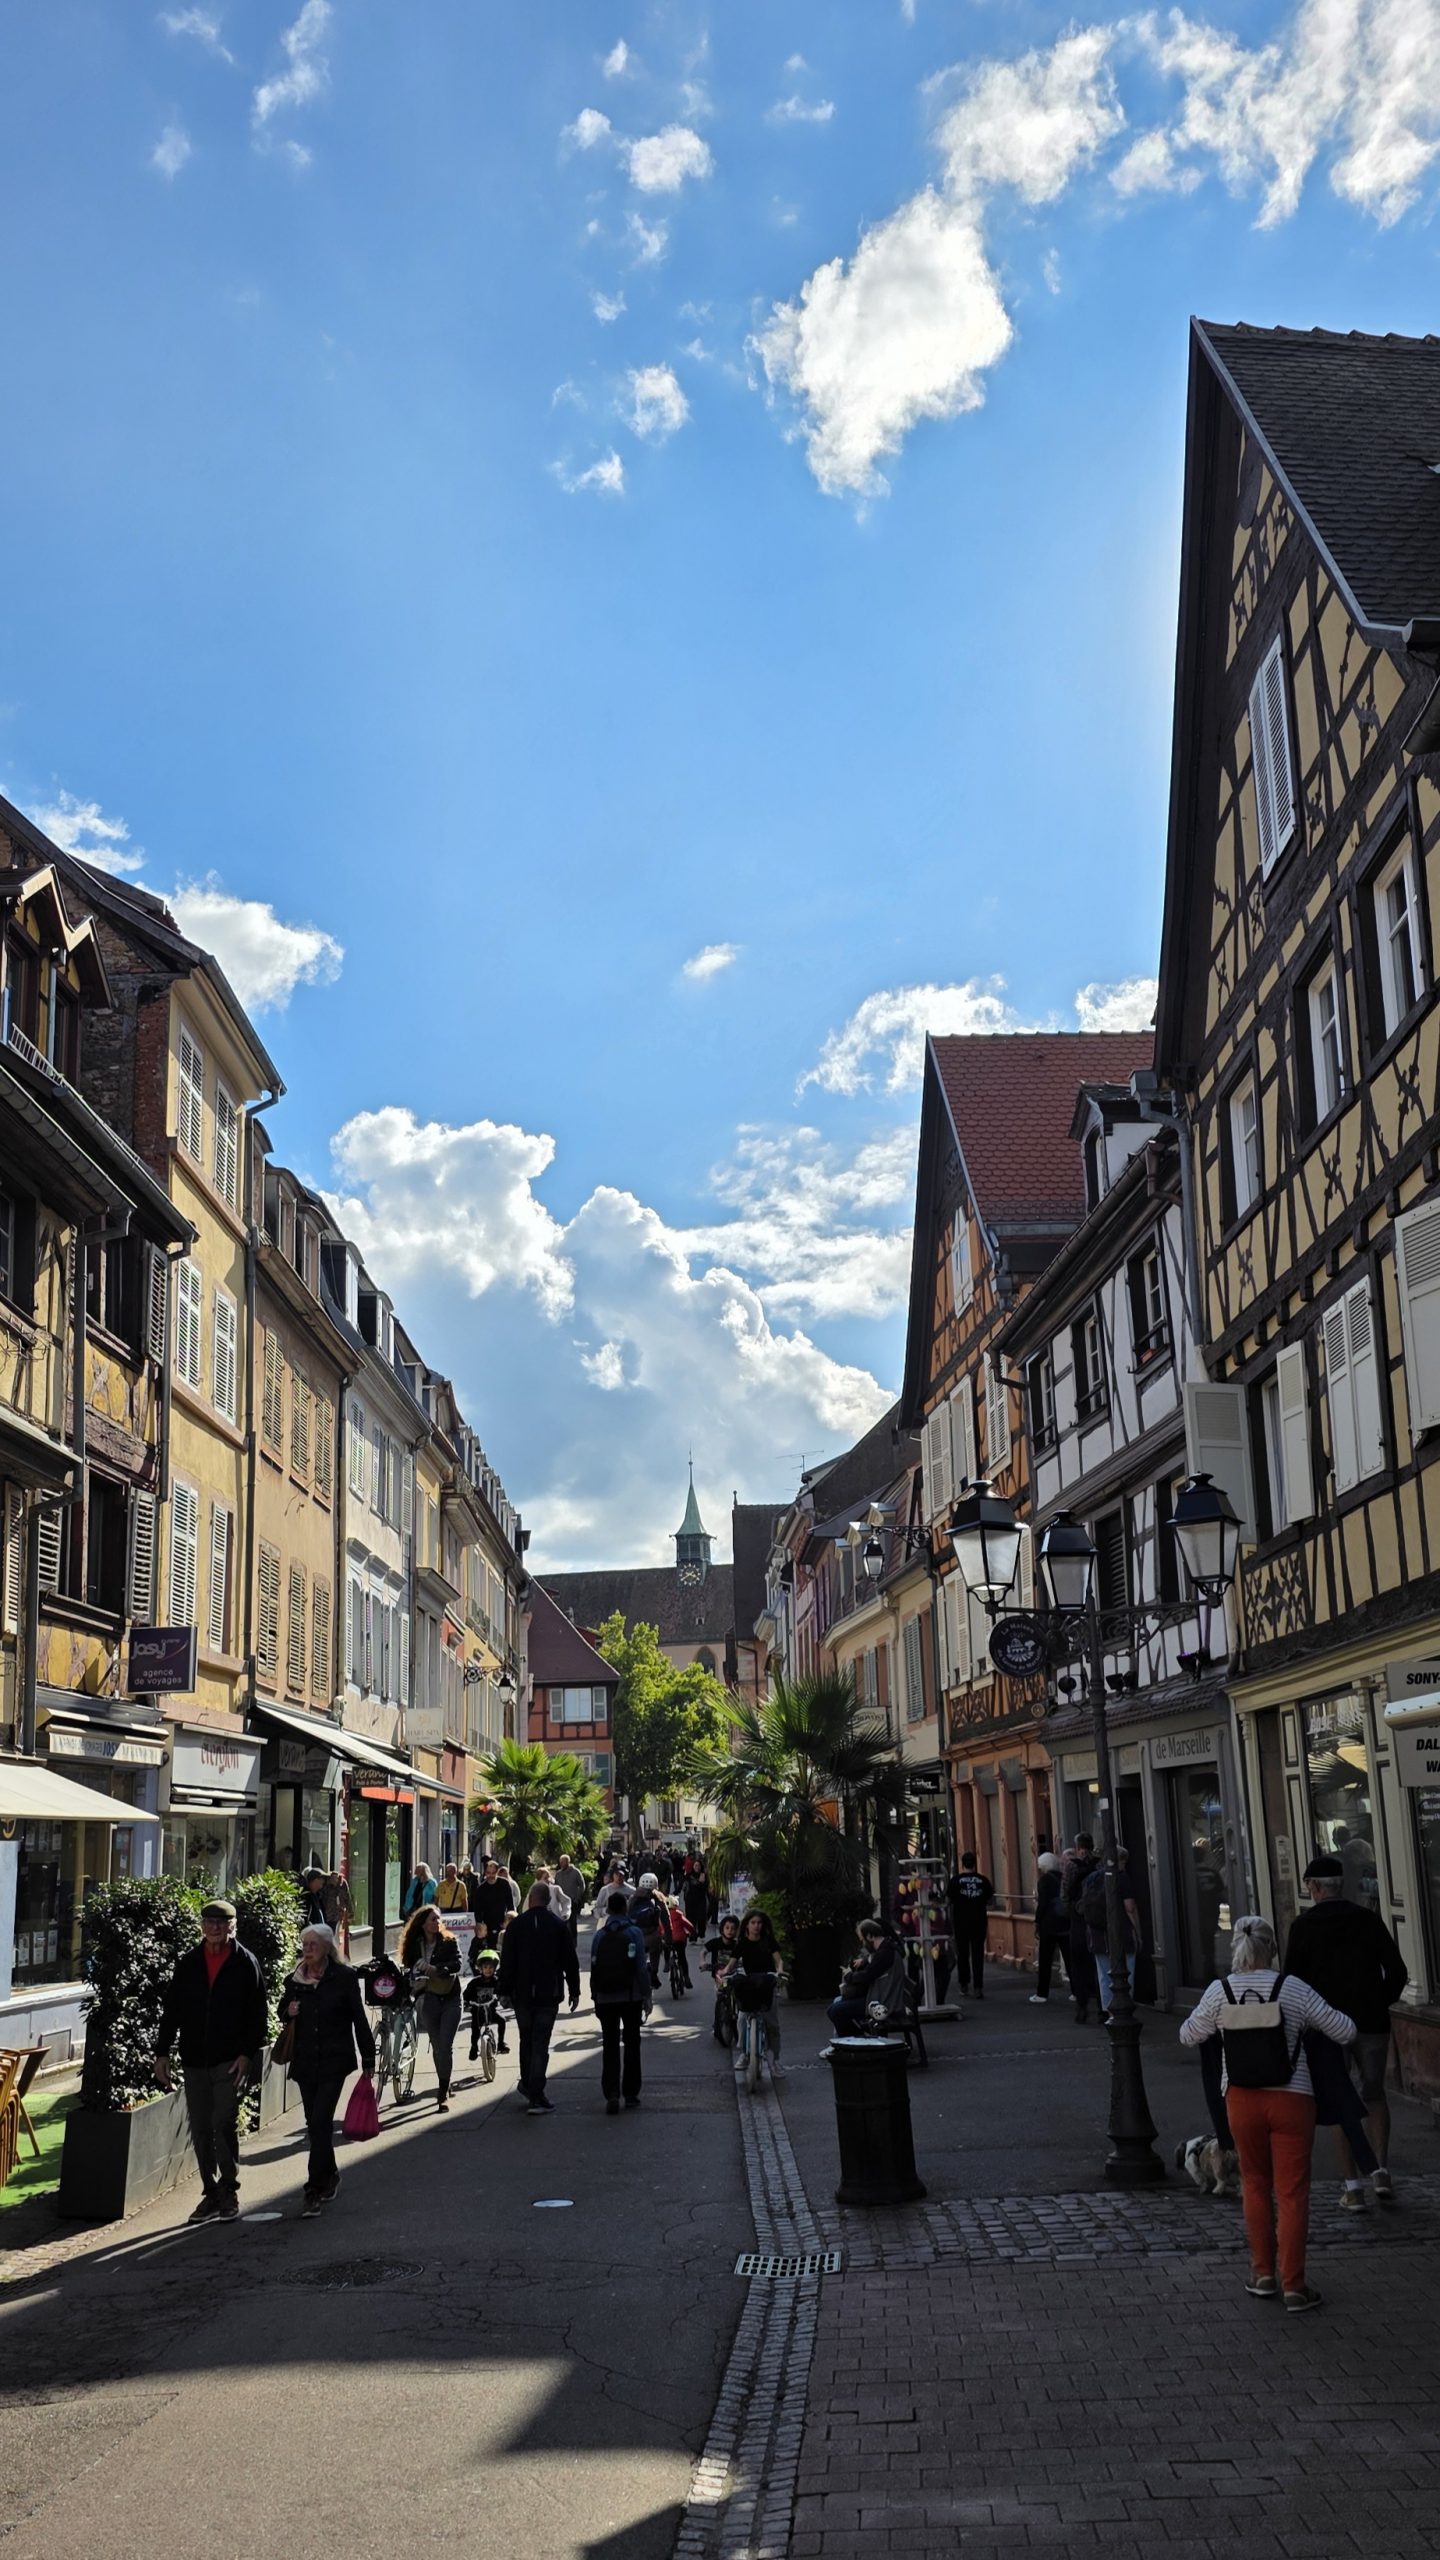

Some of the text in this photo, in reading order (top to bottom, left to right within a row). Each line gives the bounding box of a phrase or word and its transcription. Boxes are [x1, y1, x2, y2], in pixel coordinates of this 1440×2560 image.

[142, 1668, 174, 1678] agence
[133, 1676, 183, 1686] de voyages
[1155, 1738, 1167, 1760] de
[1167, 1730, 1212, 1759] Marseille
